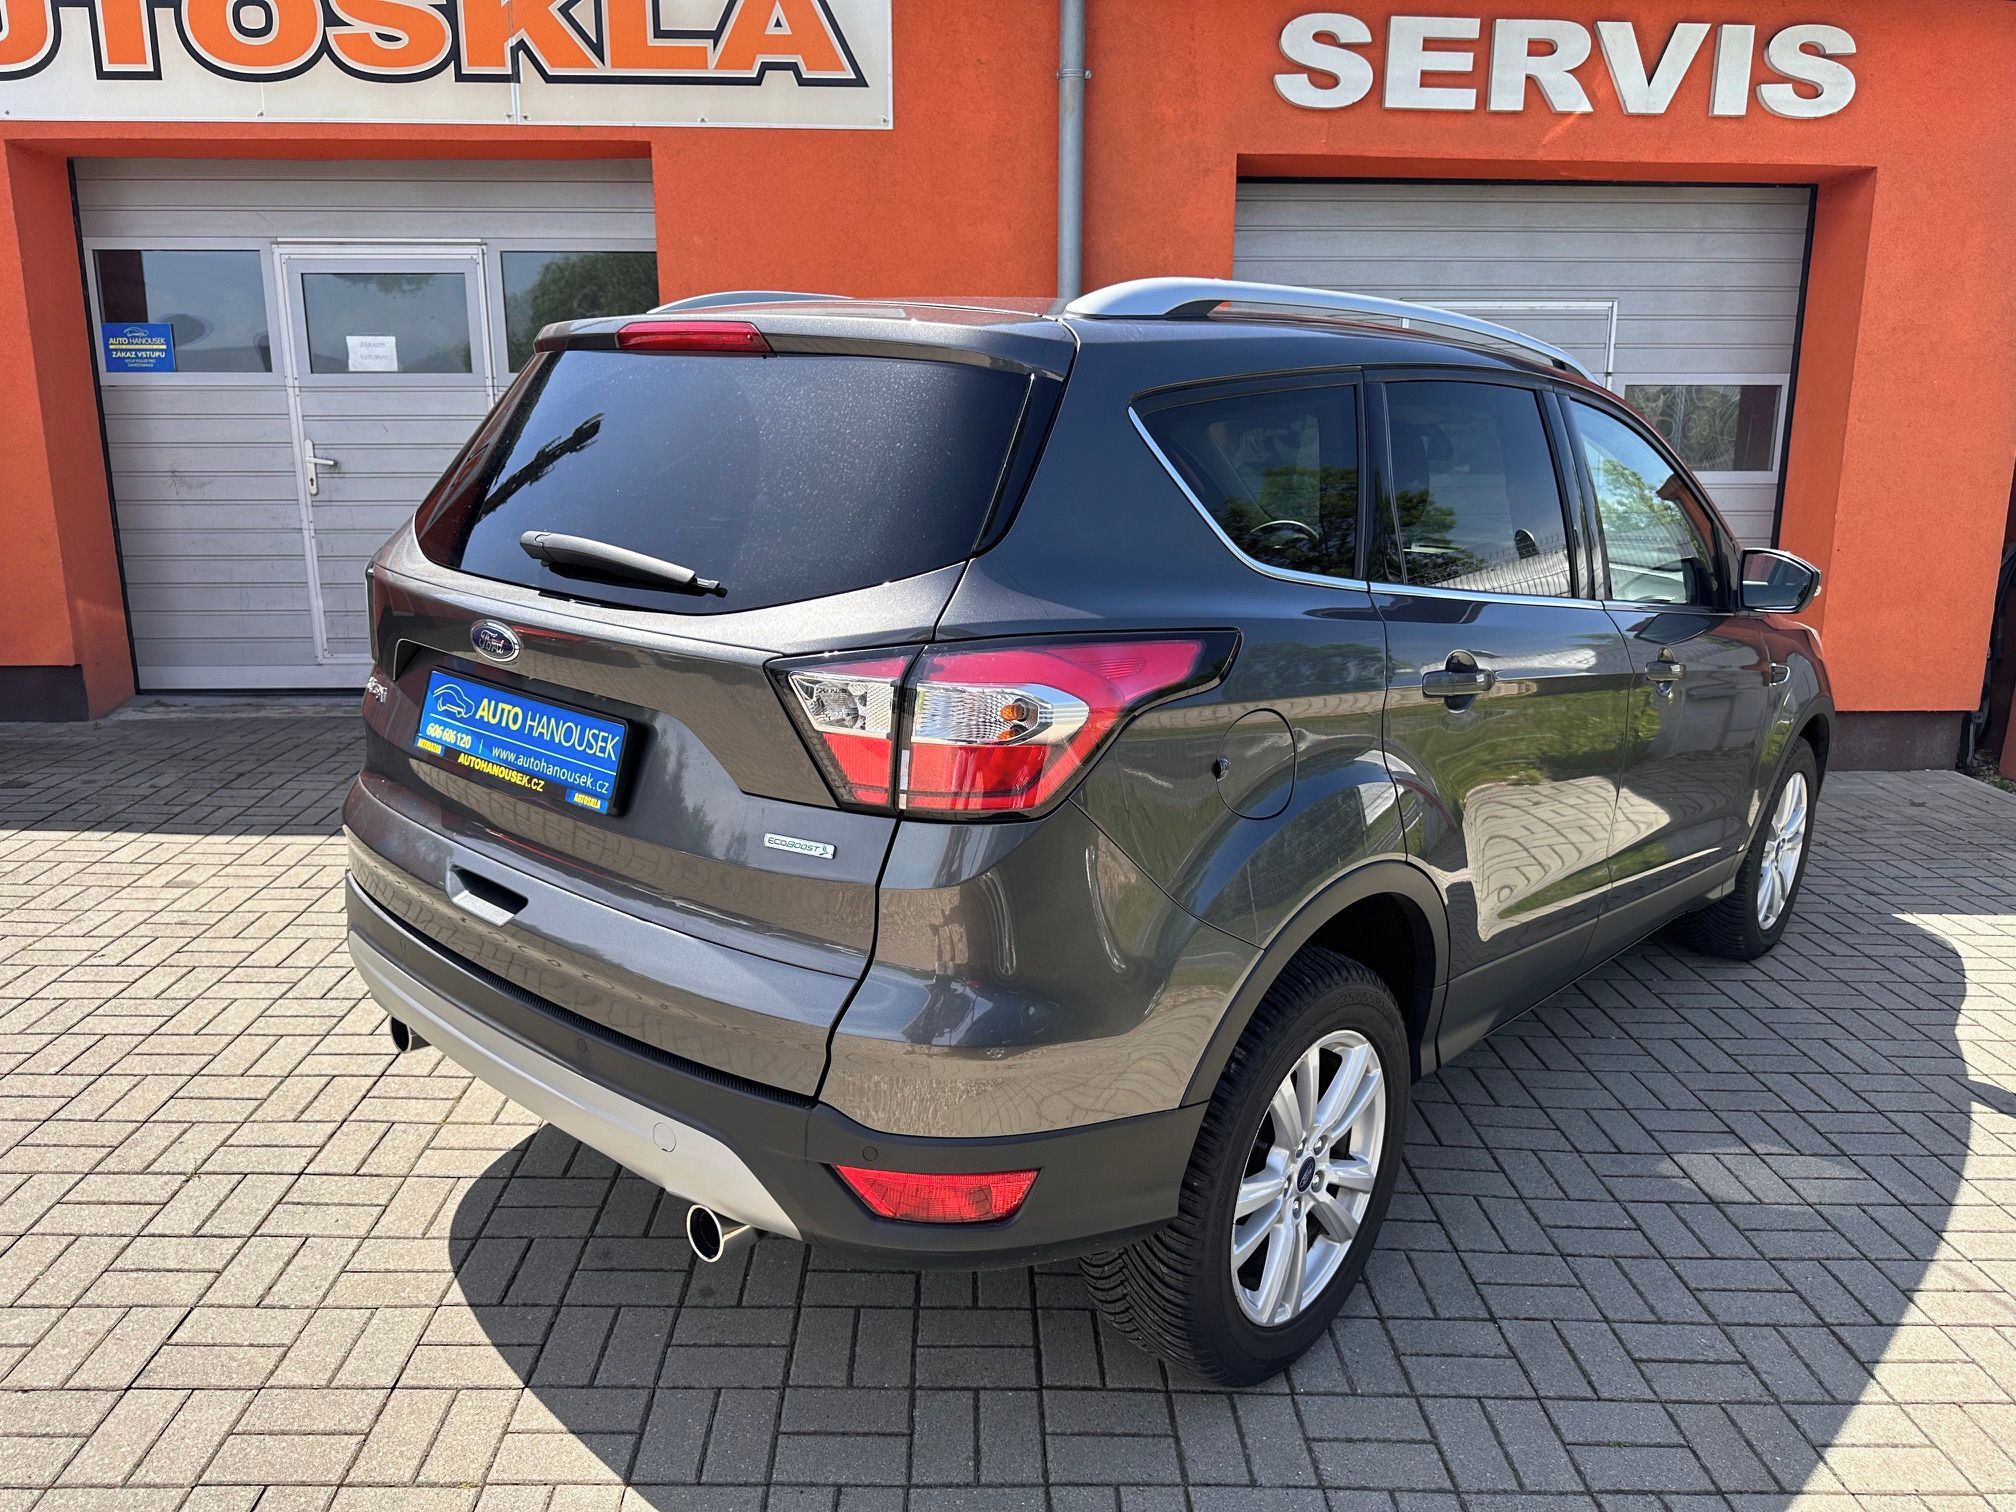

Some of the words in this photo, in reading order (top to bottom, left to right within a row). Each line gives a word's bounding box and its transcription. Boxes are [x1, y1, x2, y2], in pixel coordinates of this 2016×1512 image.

[1273, 12, 1857, 119] SERVIS
[109, 337, 129, 345] AUTO
[129, 337, 167, 345] HANOUSEK
[112, 349, 136, 358] ZÁKAZ
[475, 698, 523, 731] AUTO
[525, 710, 620, 761] HANOUSEK
[458, 752, 545, 792] AUTOHANOUSEK.CZ
[492, 745, 609, 794] www.autohanousek.cz
